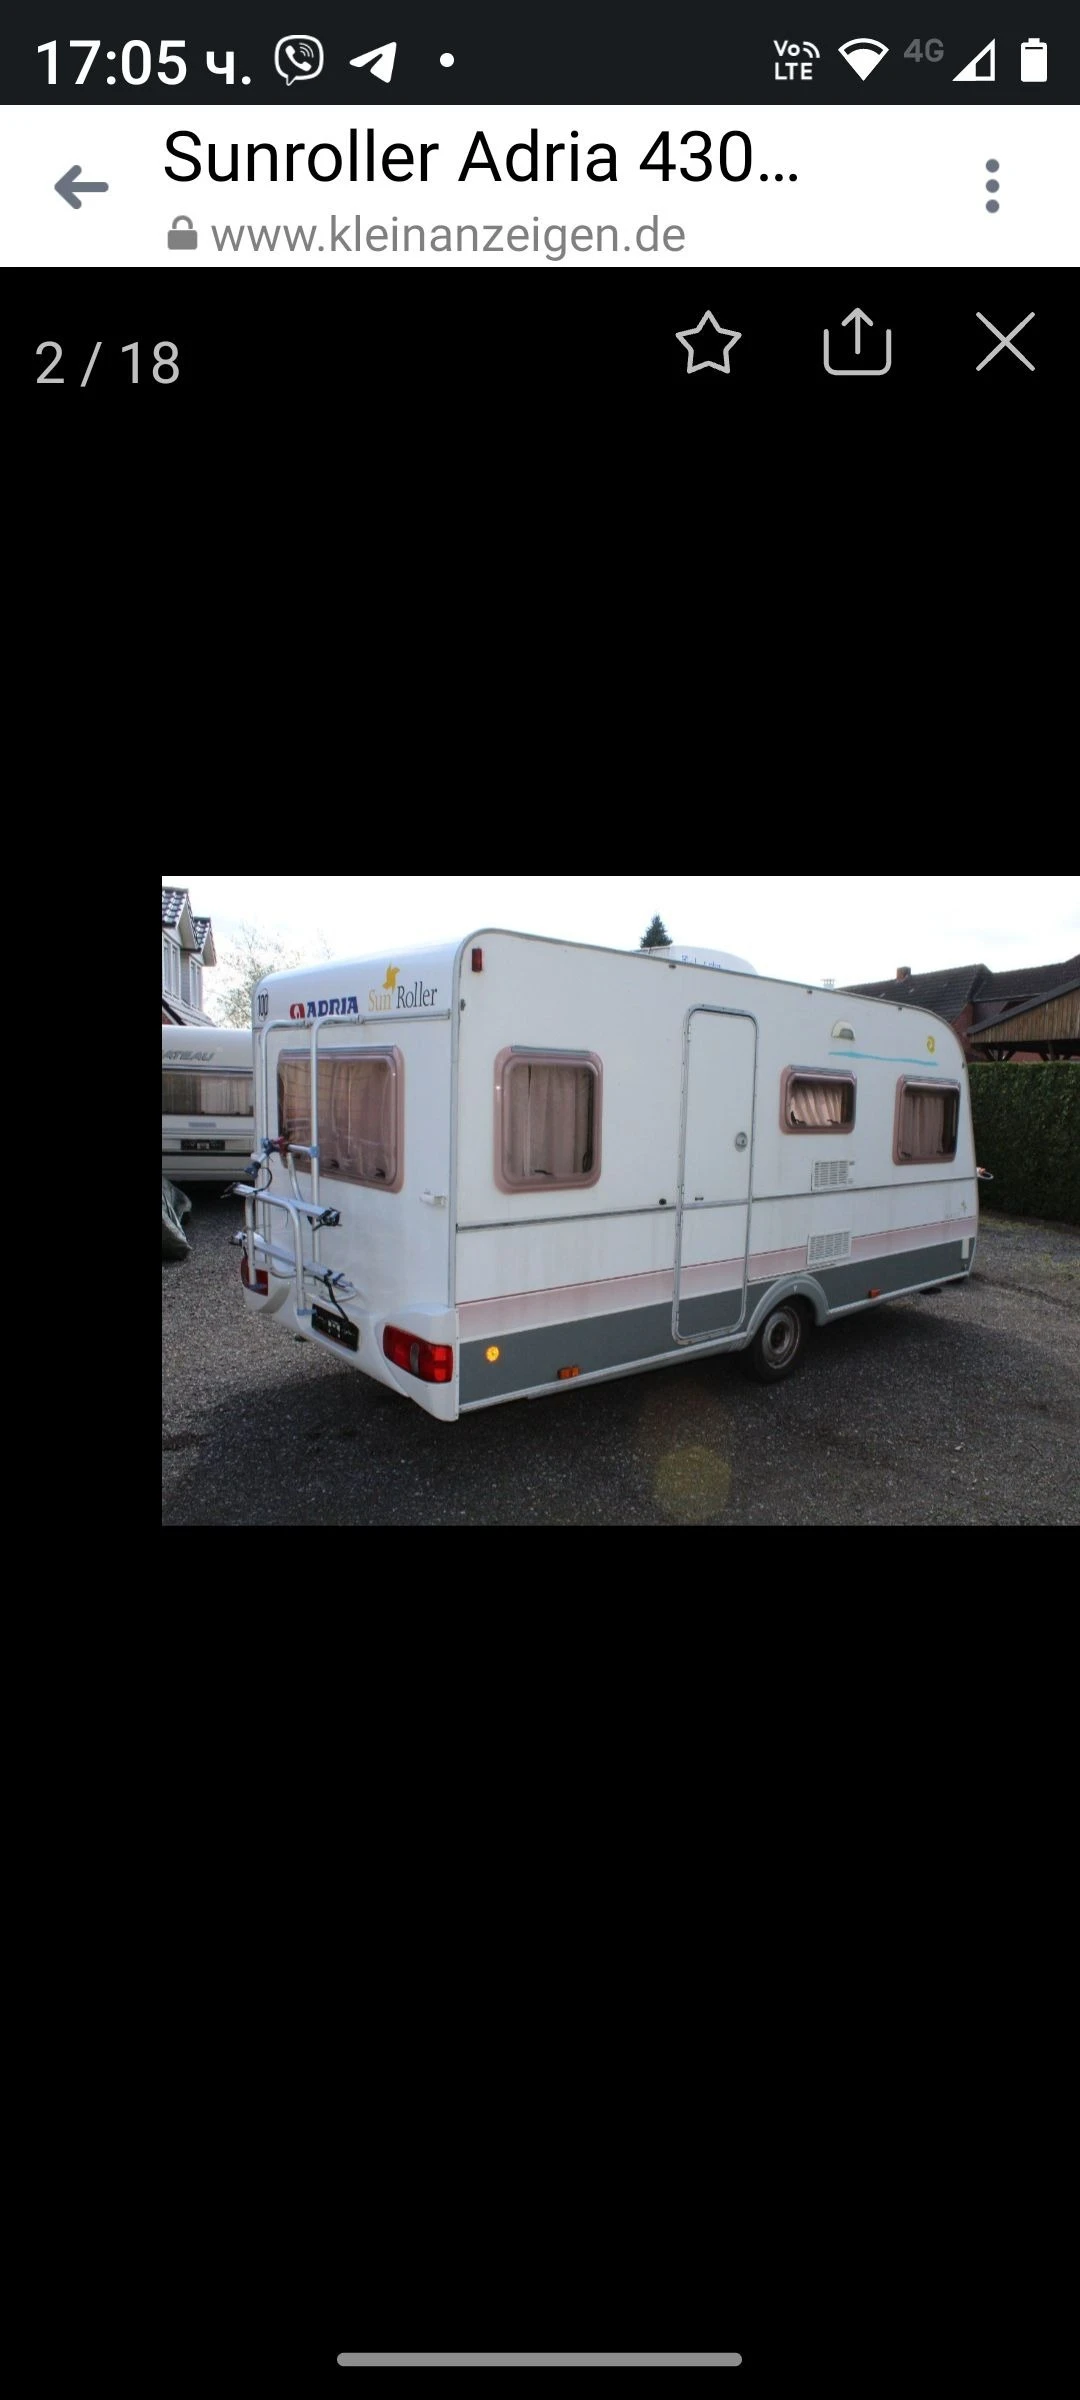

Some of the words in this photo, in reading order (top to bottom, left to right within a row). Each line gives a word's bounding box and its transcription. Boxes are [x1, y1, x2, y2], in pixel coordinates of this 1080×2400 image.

[306, 995, 359, 1018] ADRIA
[367, 989, 392, 1012] Sun
[396, 981, 438, 1009] Roller
